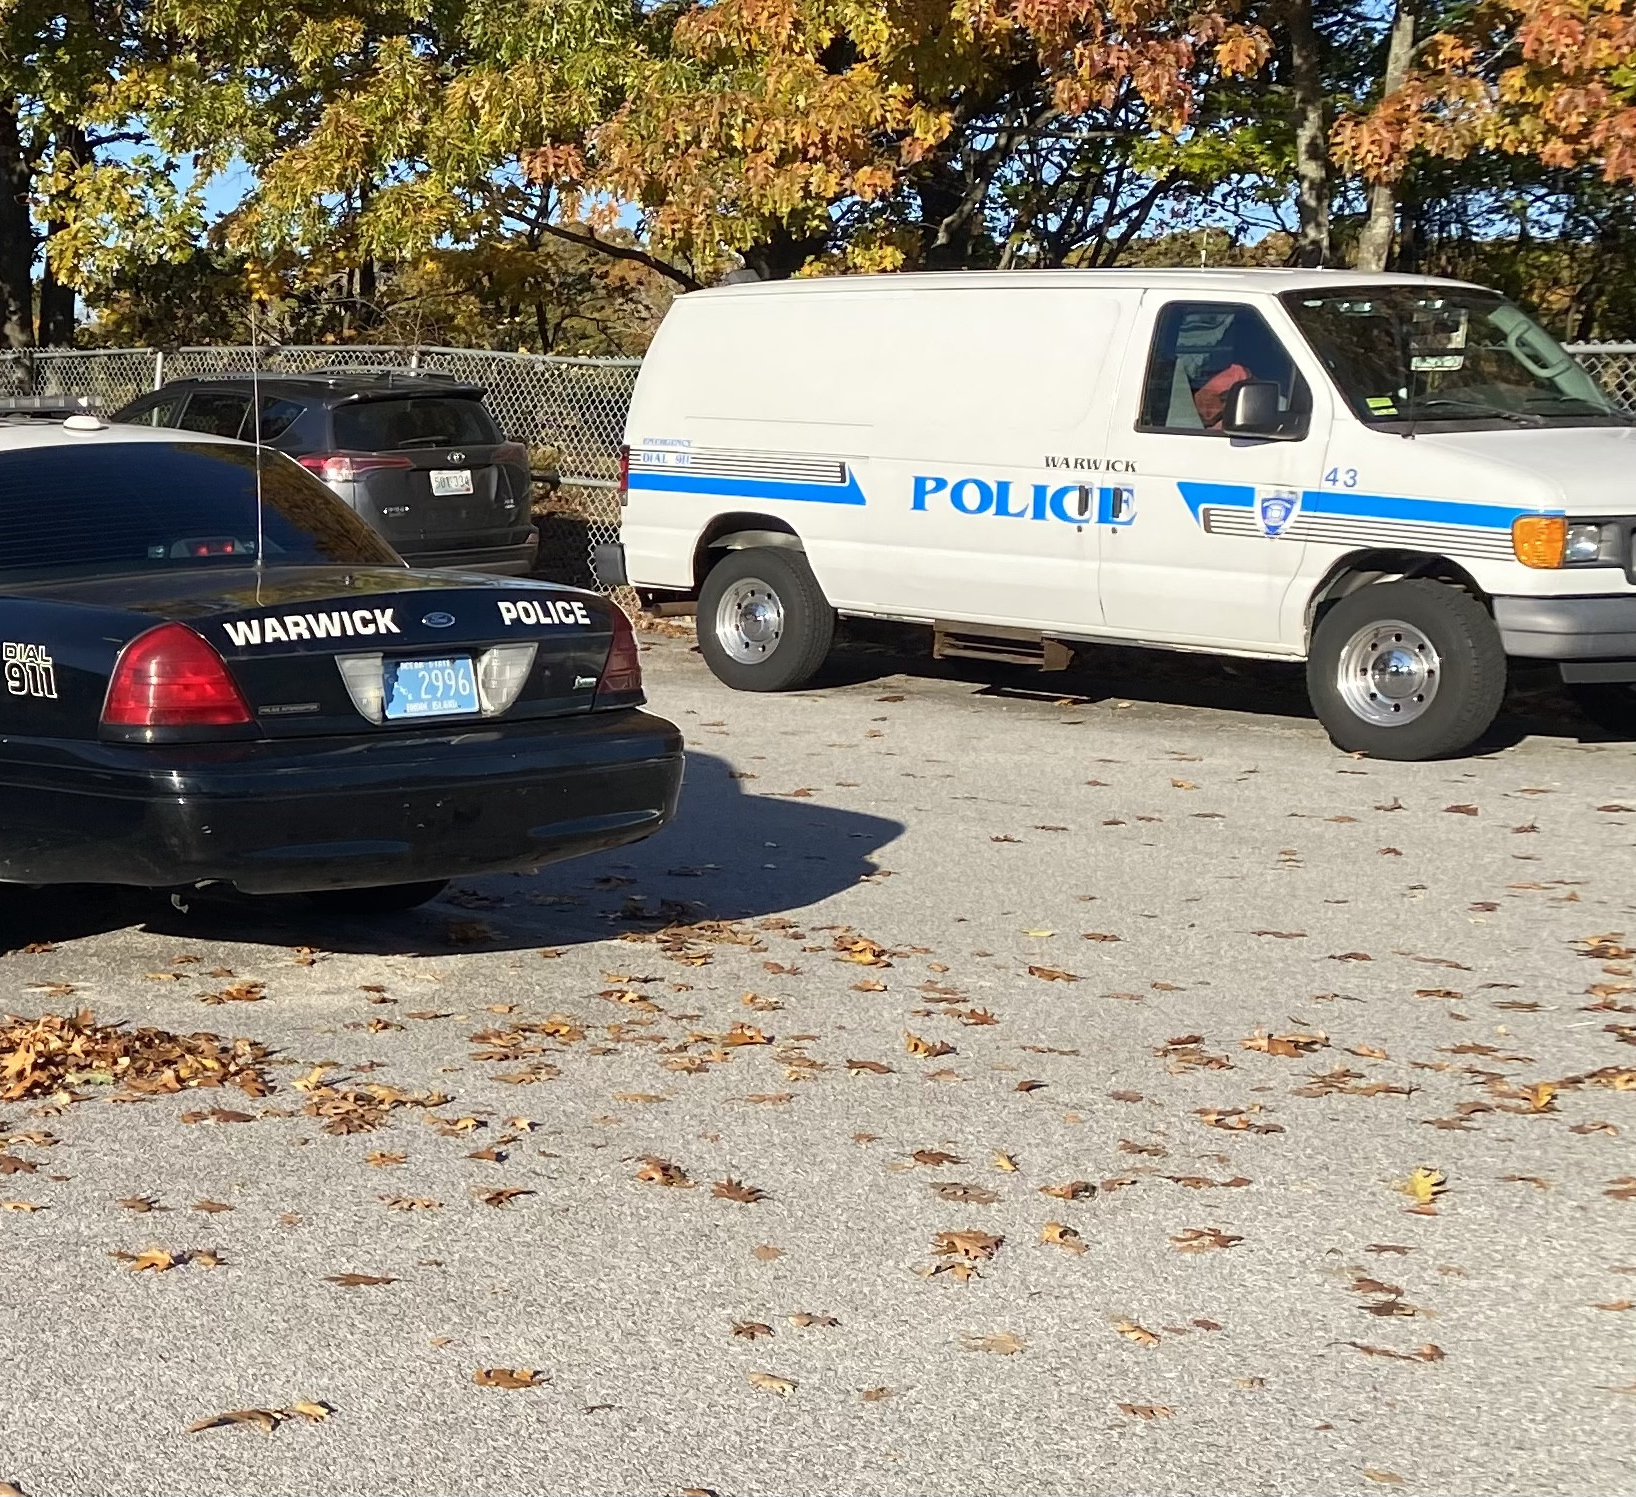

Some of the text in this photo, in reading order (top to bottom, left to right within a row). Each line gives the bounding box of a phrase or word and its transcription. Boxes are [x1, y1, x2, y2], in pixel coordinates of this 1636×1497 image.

[643, 453, 690, 464] DIAL 911
[1044, 455, 1137, 473] WARWICK
[1325, 467, 1358, 488] 43
[910, 475, 1138, 526] POLICE
[497, 601, 591, 626] POLICE
[222, 608, 402, 646] WARWICK
[3, 642, 52, 664] DIAL
[4, 660, 57, 698] 911
[418, 668, 470, 699] 2996
